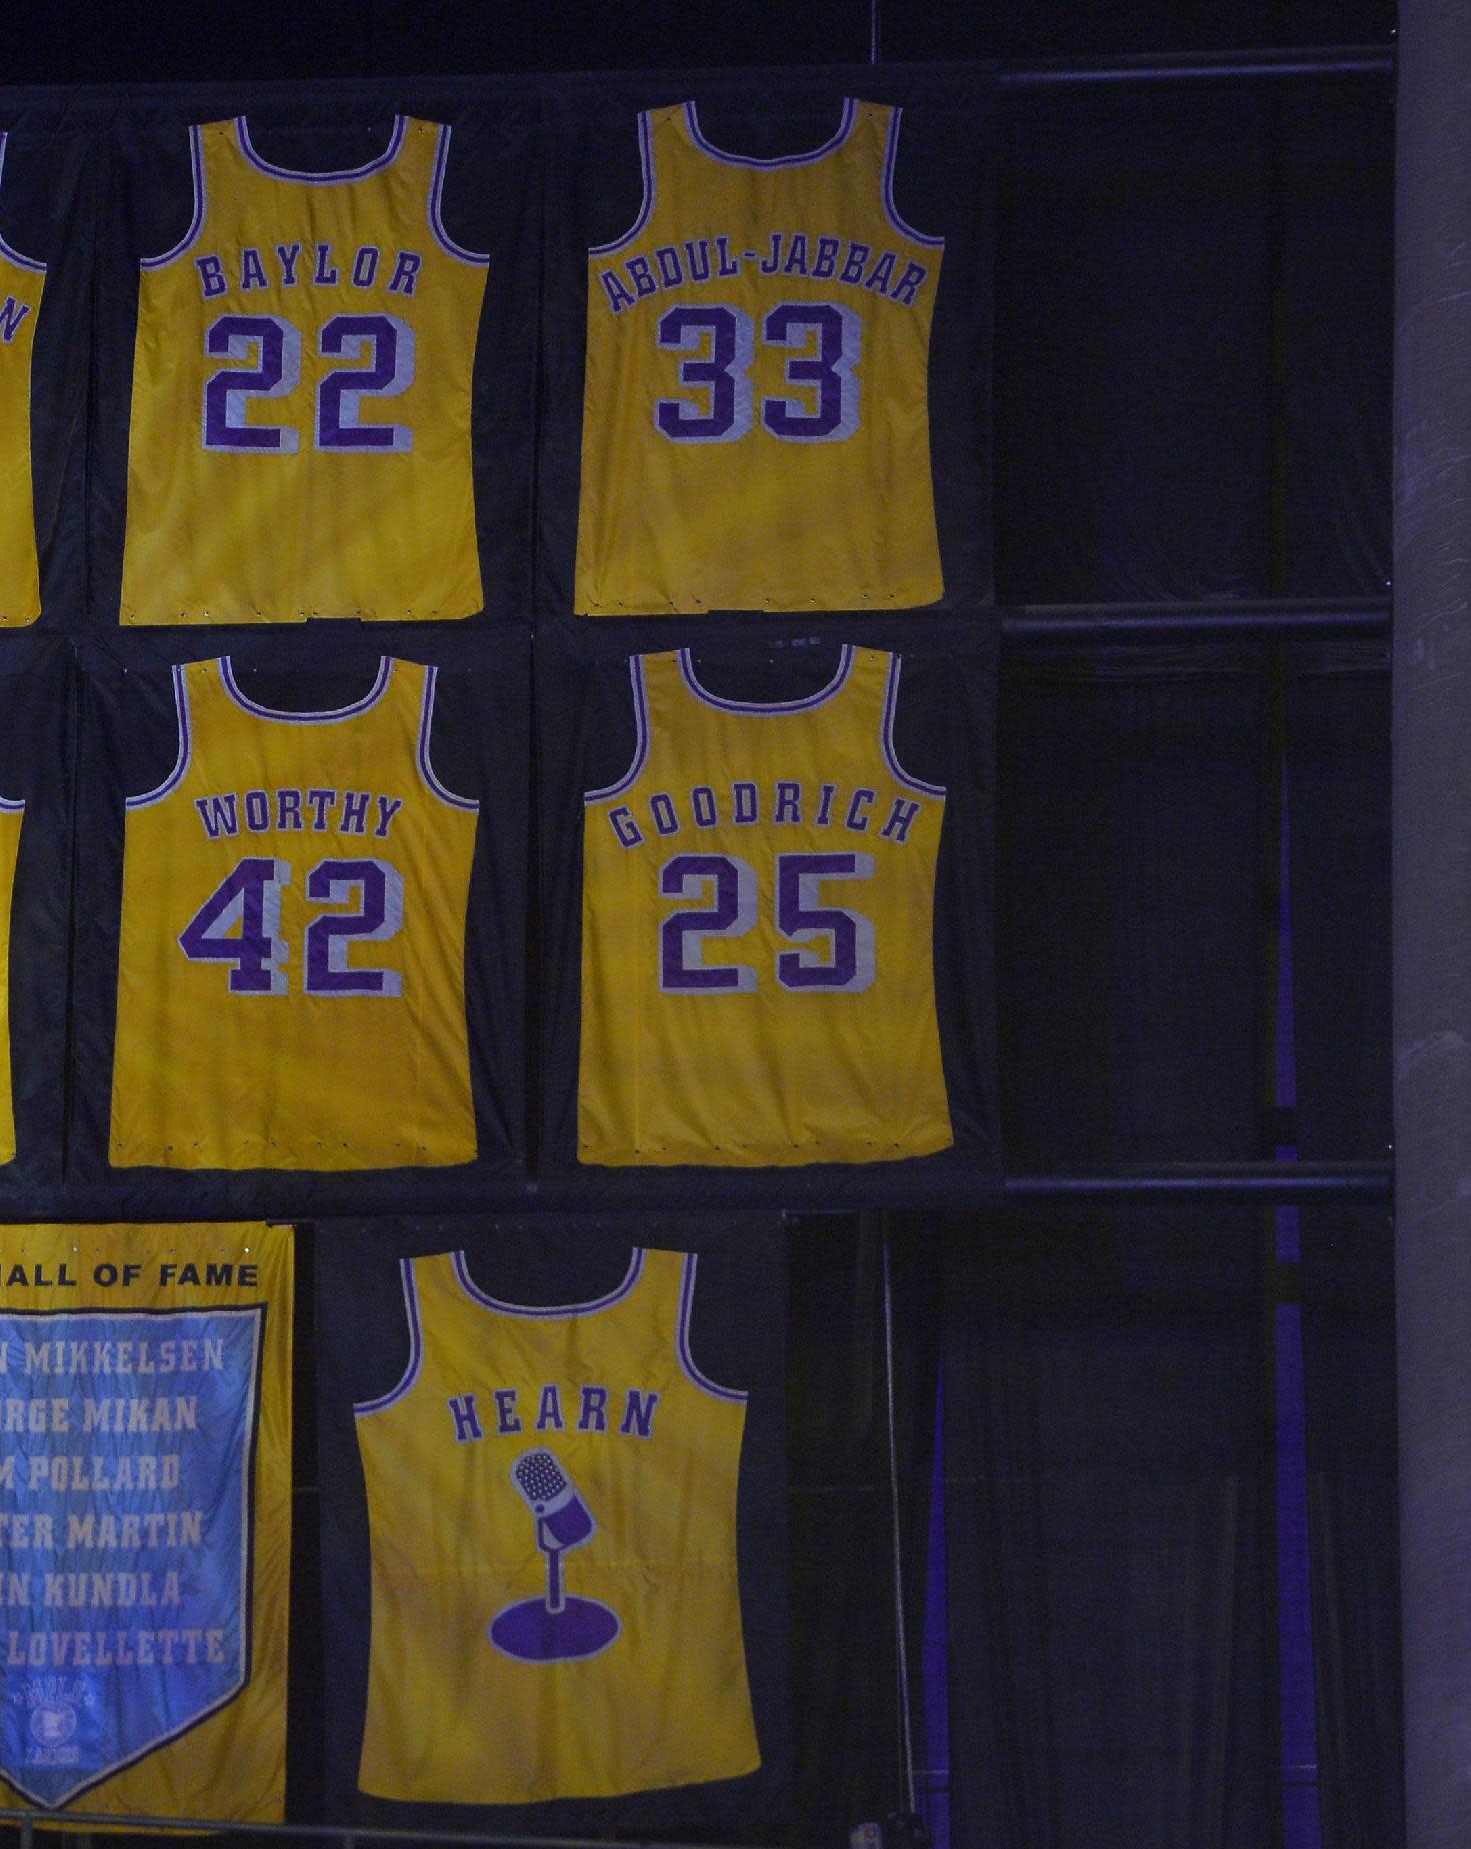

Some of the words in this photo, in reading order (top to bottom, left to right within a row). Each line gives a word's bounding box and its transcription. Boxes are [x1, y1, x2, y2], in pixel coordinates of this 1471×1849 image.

[194, 242, 423, 299] BAYLOR
[599, 231, 928, 316] ABDUL-JABBAR
[201, 311, 416, 454] 22
[653, 301, 862, 444] 33
[194, 787, 402, 840] WORTHY
[607, 781, 922, 849] GOODRICH
[178, 856, 404, 998] 42
[658, 852, 876, 994] 25
[93, 1263, 142, 1287] OF
[159, 1262, 258, 1287] FAME
[23, 1336, 224, 1376] MIKKELSEN
[83, 1396, 197, 1432] MIKAN
[448, 1384, 660, 1442] HEARN
[30, 1454, 180, 1492] POLLARD
[67, 1511, 203, 1549] MARTIN
[43, 1570, 180, 1607] KUNDLA
[6, 1629, 226, 1667] LOVELLETTE
